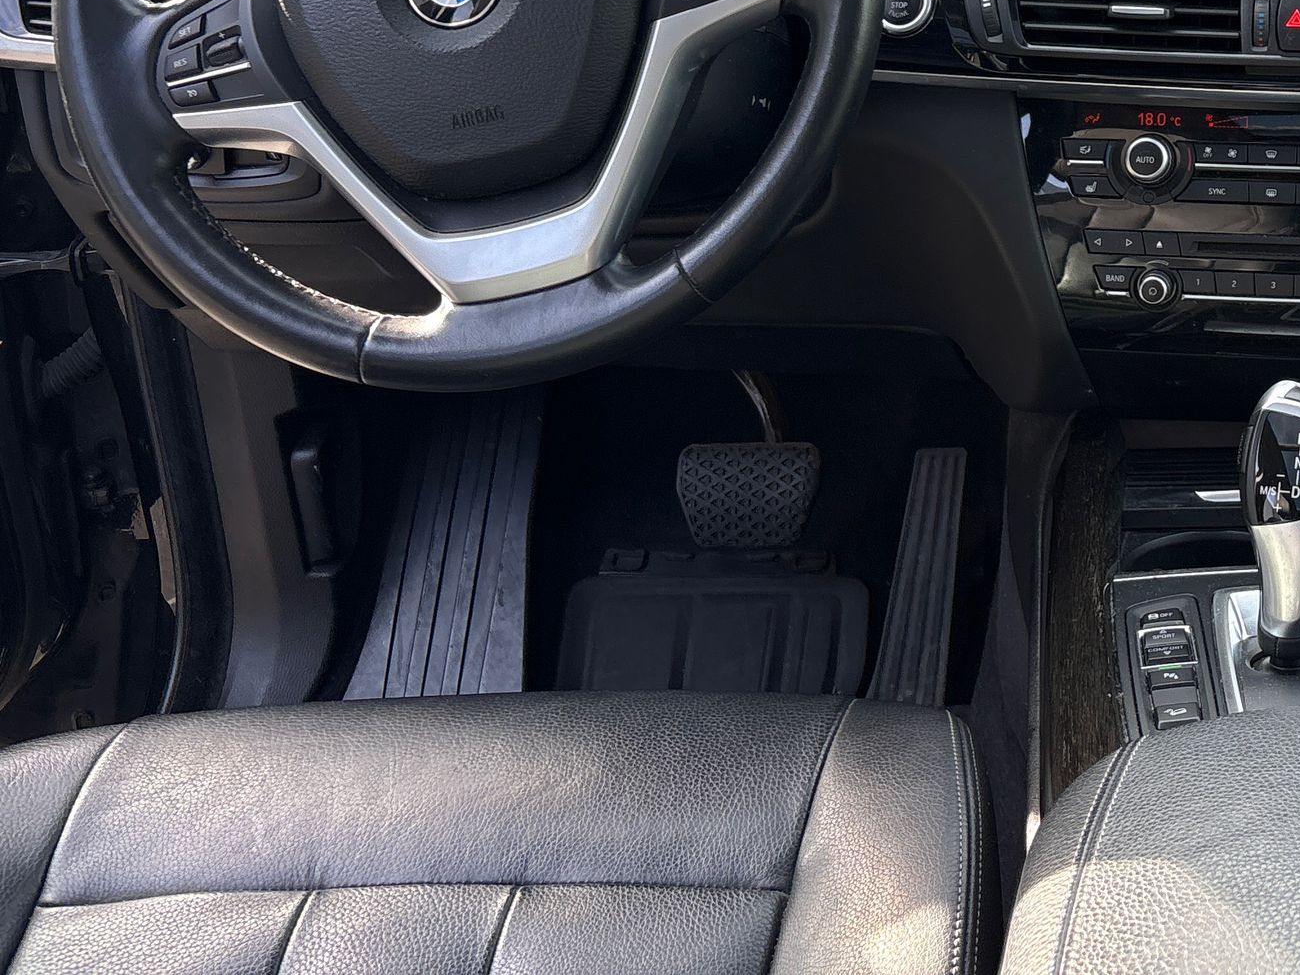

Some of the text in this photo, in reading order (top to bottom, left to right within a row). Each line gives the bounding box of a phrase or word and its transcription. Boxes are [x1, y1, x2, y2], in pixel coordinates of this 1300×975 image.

[890, 1, 909, 9] STOP
[178, 26, 191, 38] SET
[173, 57, 188, 69] RES
[451, 104, 505, 130] AIRBAG
[1137, 112, 1167, 127] 18.0
[1135, 155, 1155, 164] AUTO
[1208, 187, 1226, 196] SYNC
[1105, 274, 1125, 283] BAND
[1231, 280, 1237, 288] 2
[1271, 281, 1277, 289] 3
[1260, 485, 1300, 498] M/S D
[1152, 632, 1175, 640] SPORT
[1147, 645, 1184, 653] COMFORT
